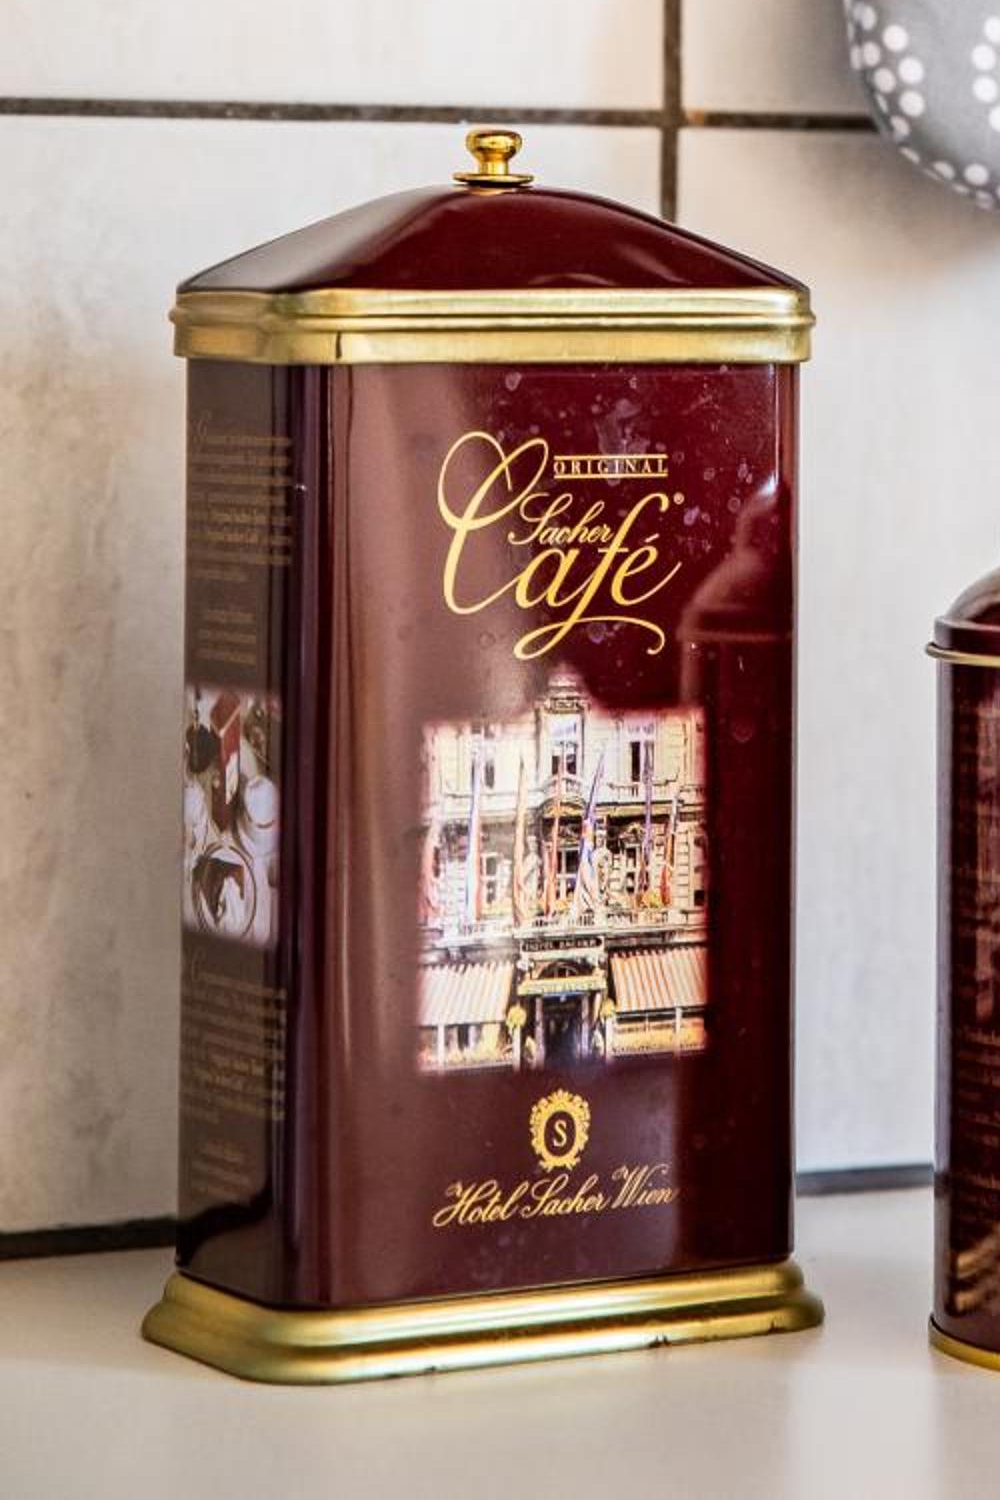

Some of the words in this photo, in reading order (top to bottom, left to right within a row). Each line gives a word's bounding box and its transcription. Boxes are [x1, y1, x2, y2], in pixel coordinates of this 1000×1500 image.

[553, 458, 669, 476] ORIGINAL
[437, 430, 682, 660] Café
[507, 492, 614, 545] Sacher
[552, 1119, 568, 1148] S
[432, 1179, 529, 1227] Hotel
[521, 1173, 610, 1219] Sacher
[611, 1162, 678, 1209] Wien
